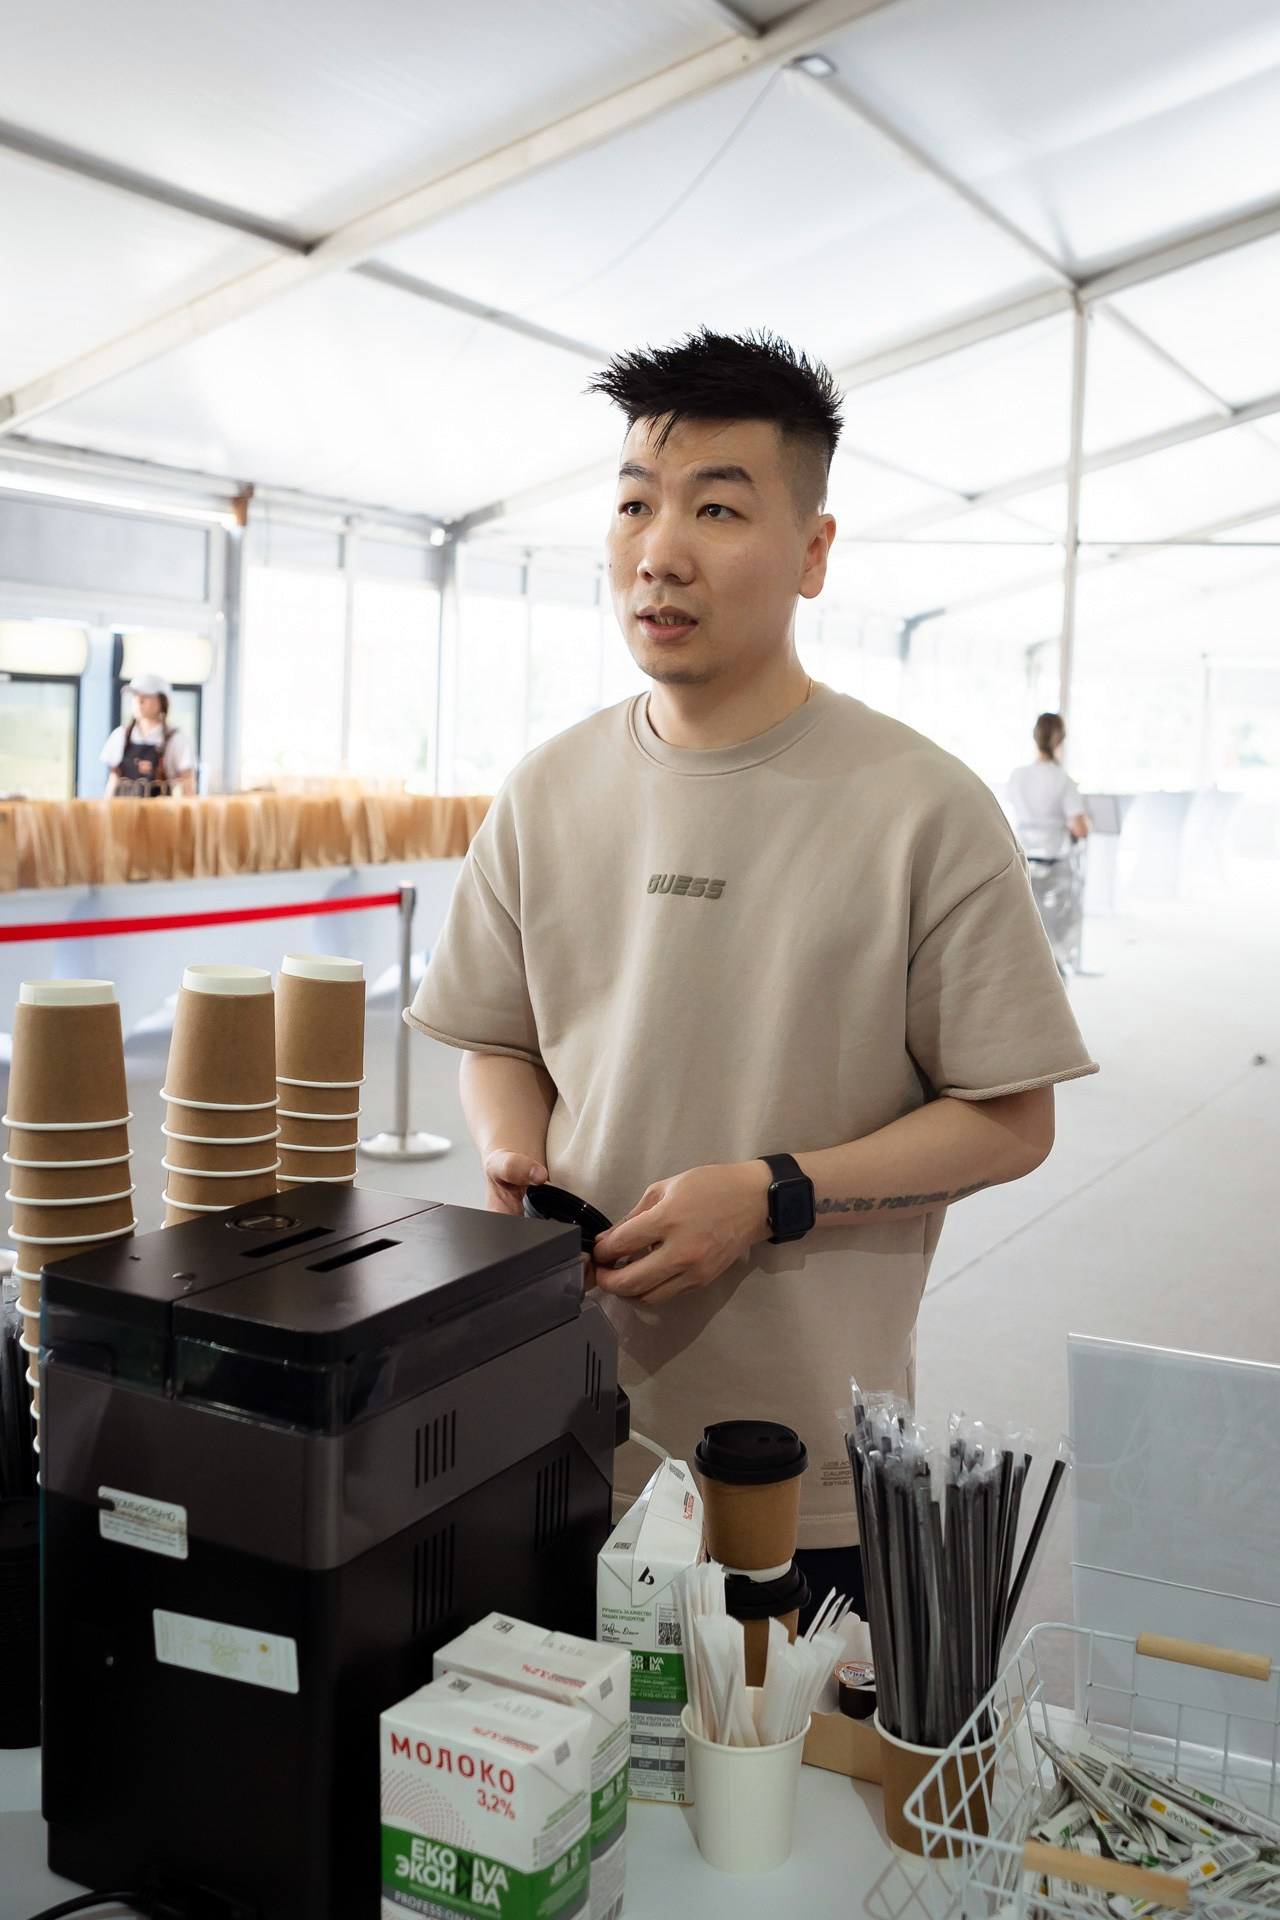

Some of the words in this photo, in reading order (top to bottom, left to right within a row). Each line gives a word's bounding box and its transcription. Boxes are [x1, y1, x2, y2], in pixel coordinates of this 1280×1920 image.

[647, 874, 726, 899] GUESS
[391, 1732, 515, 1794] МОЛОКО
[477, 1788, 516, 1821] 3,2%
